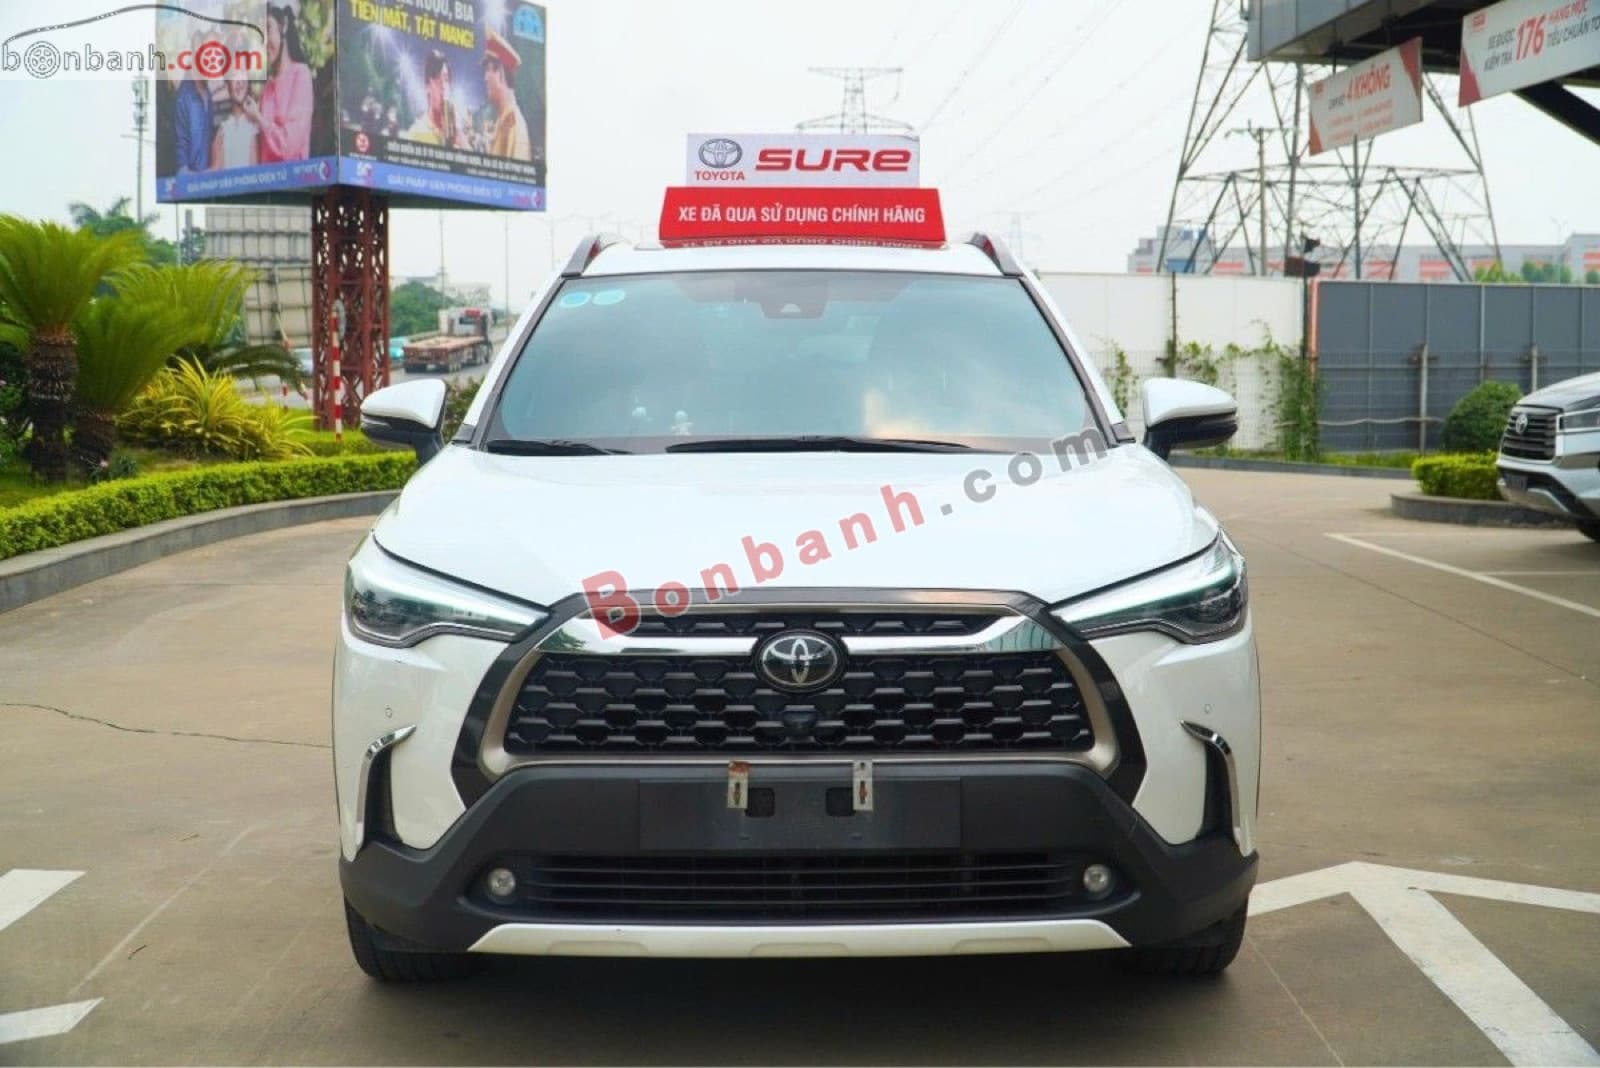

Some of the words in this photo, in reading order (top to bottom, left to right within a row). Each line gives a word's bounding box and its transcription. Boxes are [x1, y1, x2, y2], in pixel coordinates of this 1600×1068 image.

[455, 1, 474, 22] BIA
[1514, 14, 1546, 62] 176
[694, 171, 745, 181] TOYOTA
[678, 206, 697, 222] XE
[701, 203, 722, 222] ĐÃ
[725, 206, 757, 223] QUA
[760, 202, 784, 223] SỬ
[786, 206, 828, 226] DỤNG
[831, 203, 880, 223] CHÍNH
[883, 205, 926, 224] HÃNG
